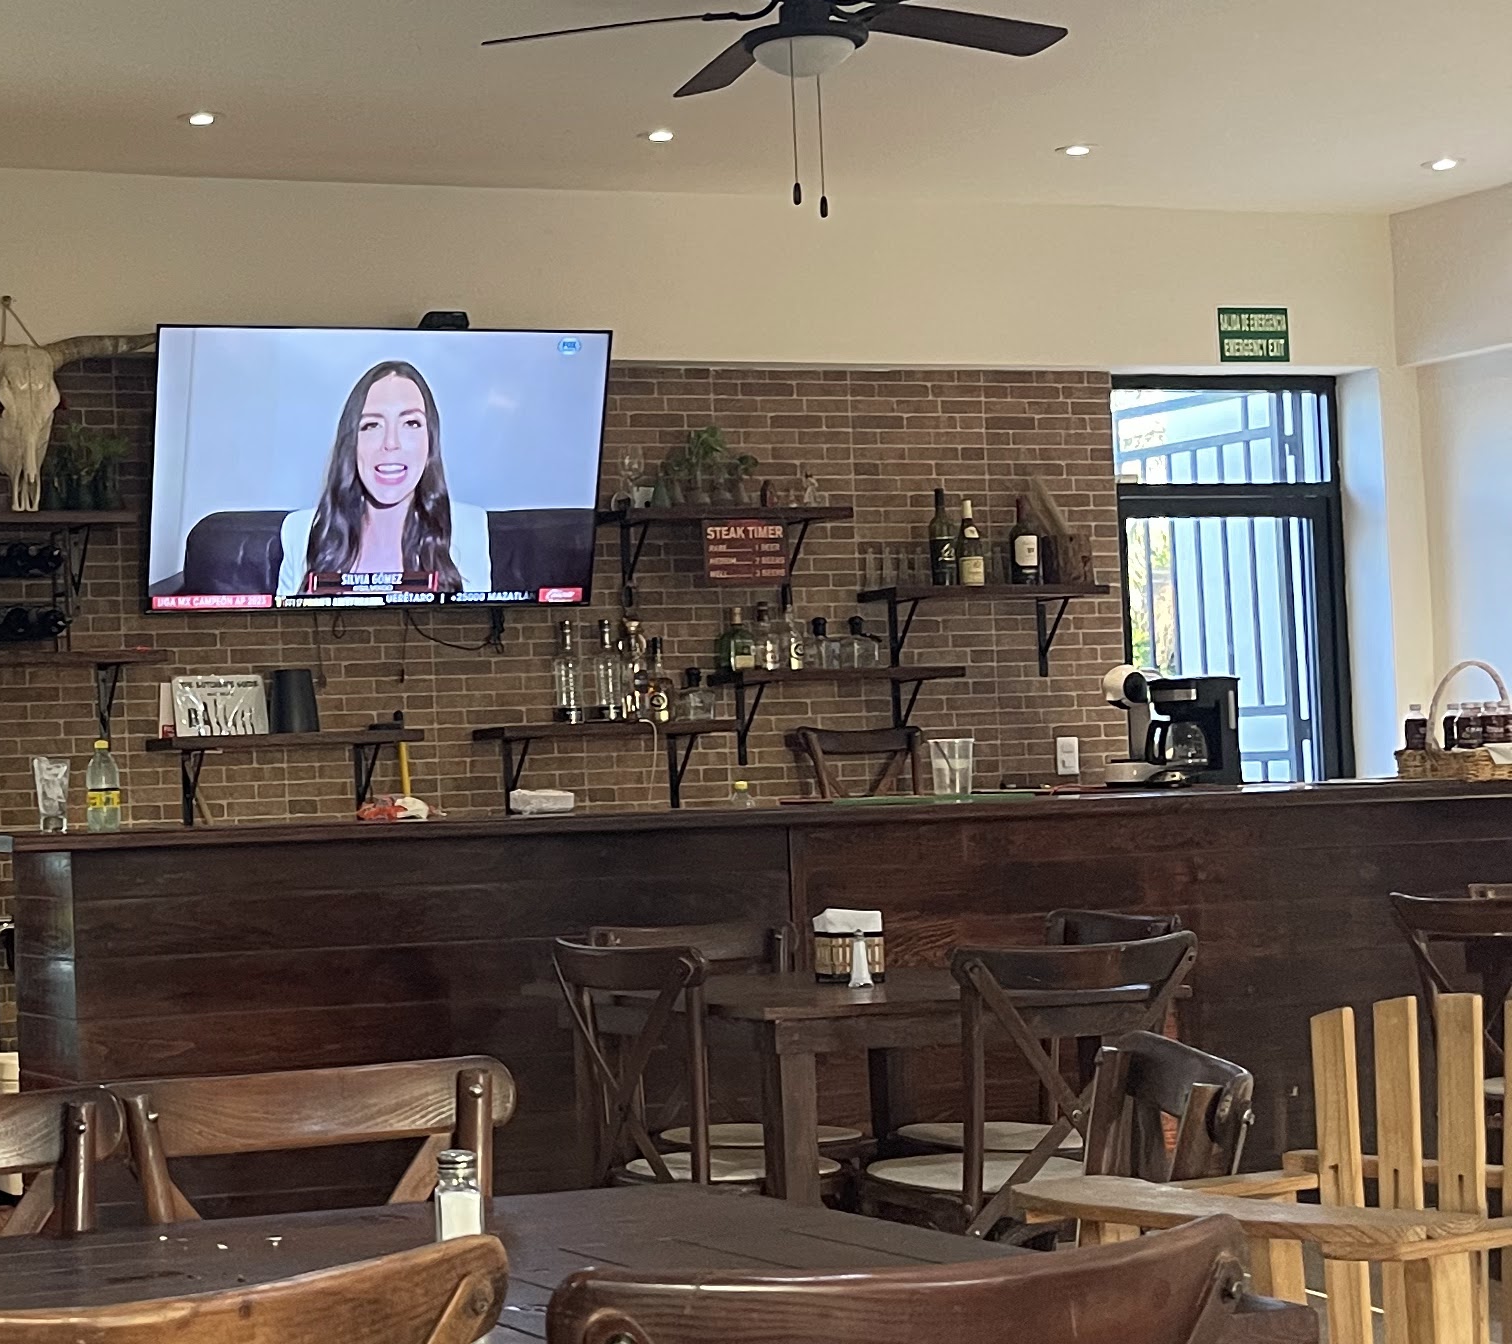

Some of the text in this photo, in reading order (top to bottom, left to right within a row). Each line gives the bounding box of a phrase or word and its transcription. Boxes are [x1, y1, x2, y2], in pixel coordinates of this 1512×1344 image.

[1224, 339, 1285, 356] EMERGENCY EXIT
[707, 526, 784, 539] STEAK TIMER
[341, 572, 403, 585] SILVIA GÓMEZ
[192, 594, 233, 606] CAMPEÓN
[385, 590, 435, 603] UERÉTARO
